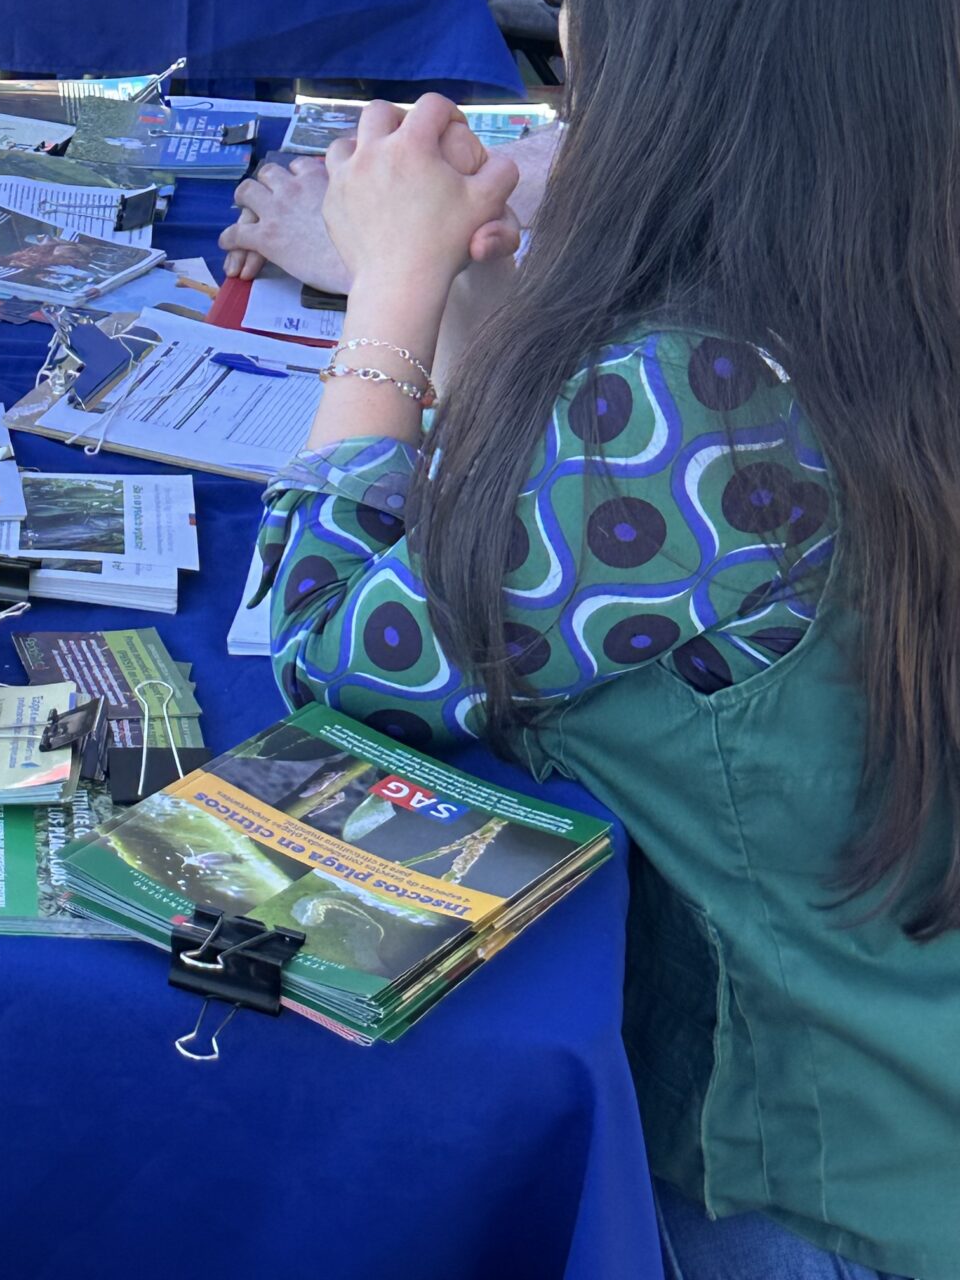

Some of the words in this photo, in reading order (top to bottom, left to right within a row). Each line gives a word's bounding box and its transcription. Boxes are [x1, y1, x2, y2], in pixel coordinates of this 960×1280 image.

[47, 807, 64, 824] LOS
[194, 792, 275, 838] cítricos
[381, 781, 458, 819] SAG
[277, 836, 305, 853] en
[308, 851, 374, 882] plaga
[133, 880, 192, 915] GANADERO
[372, 879, 472, 916] Insectos
